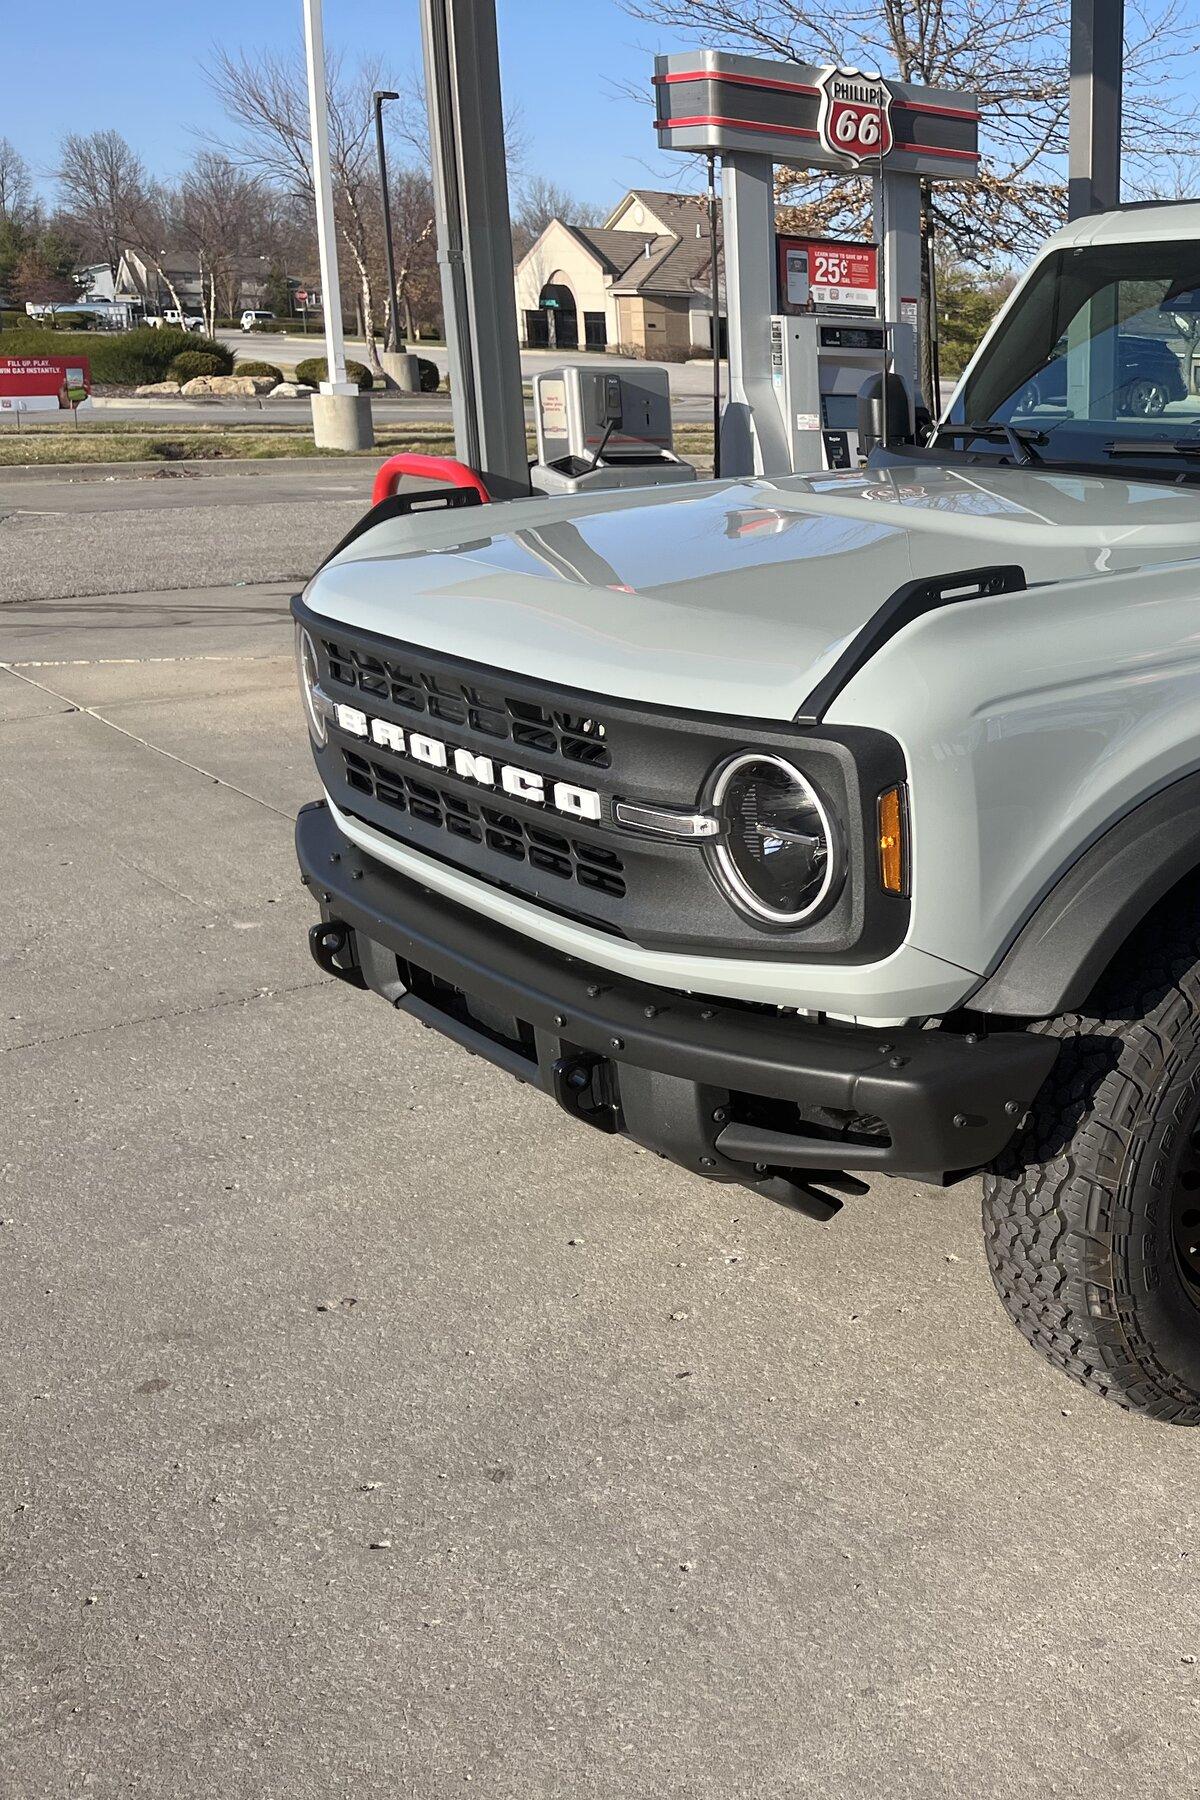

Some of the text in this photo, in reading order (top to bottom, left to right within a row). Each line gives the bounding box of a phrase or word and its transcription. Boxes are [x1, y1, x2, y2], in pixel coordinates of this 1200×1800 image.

[832, 82, 884, 106] PHILLIPS
[836, 109, 881, 145] 66
[335, 703, 602, 820] BRONCO
